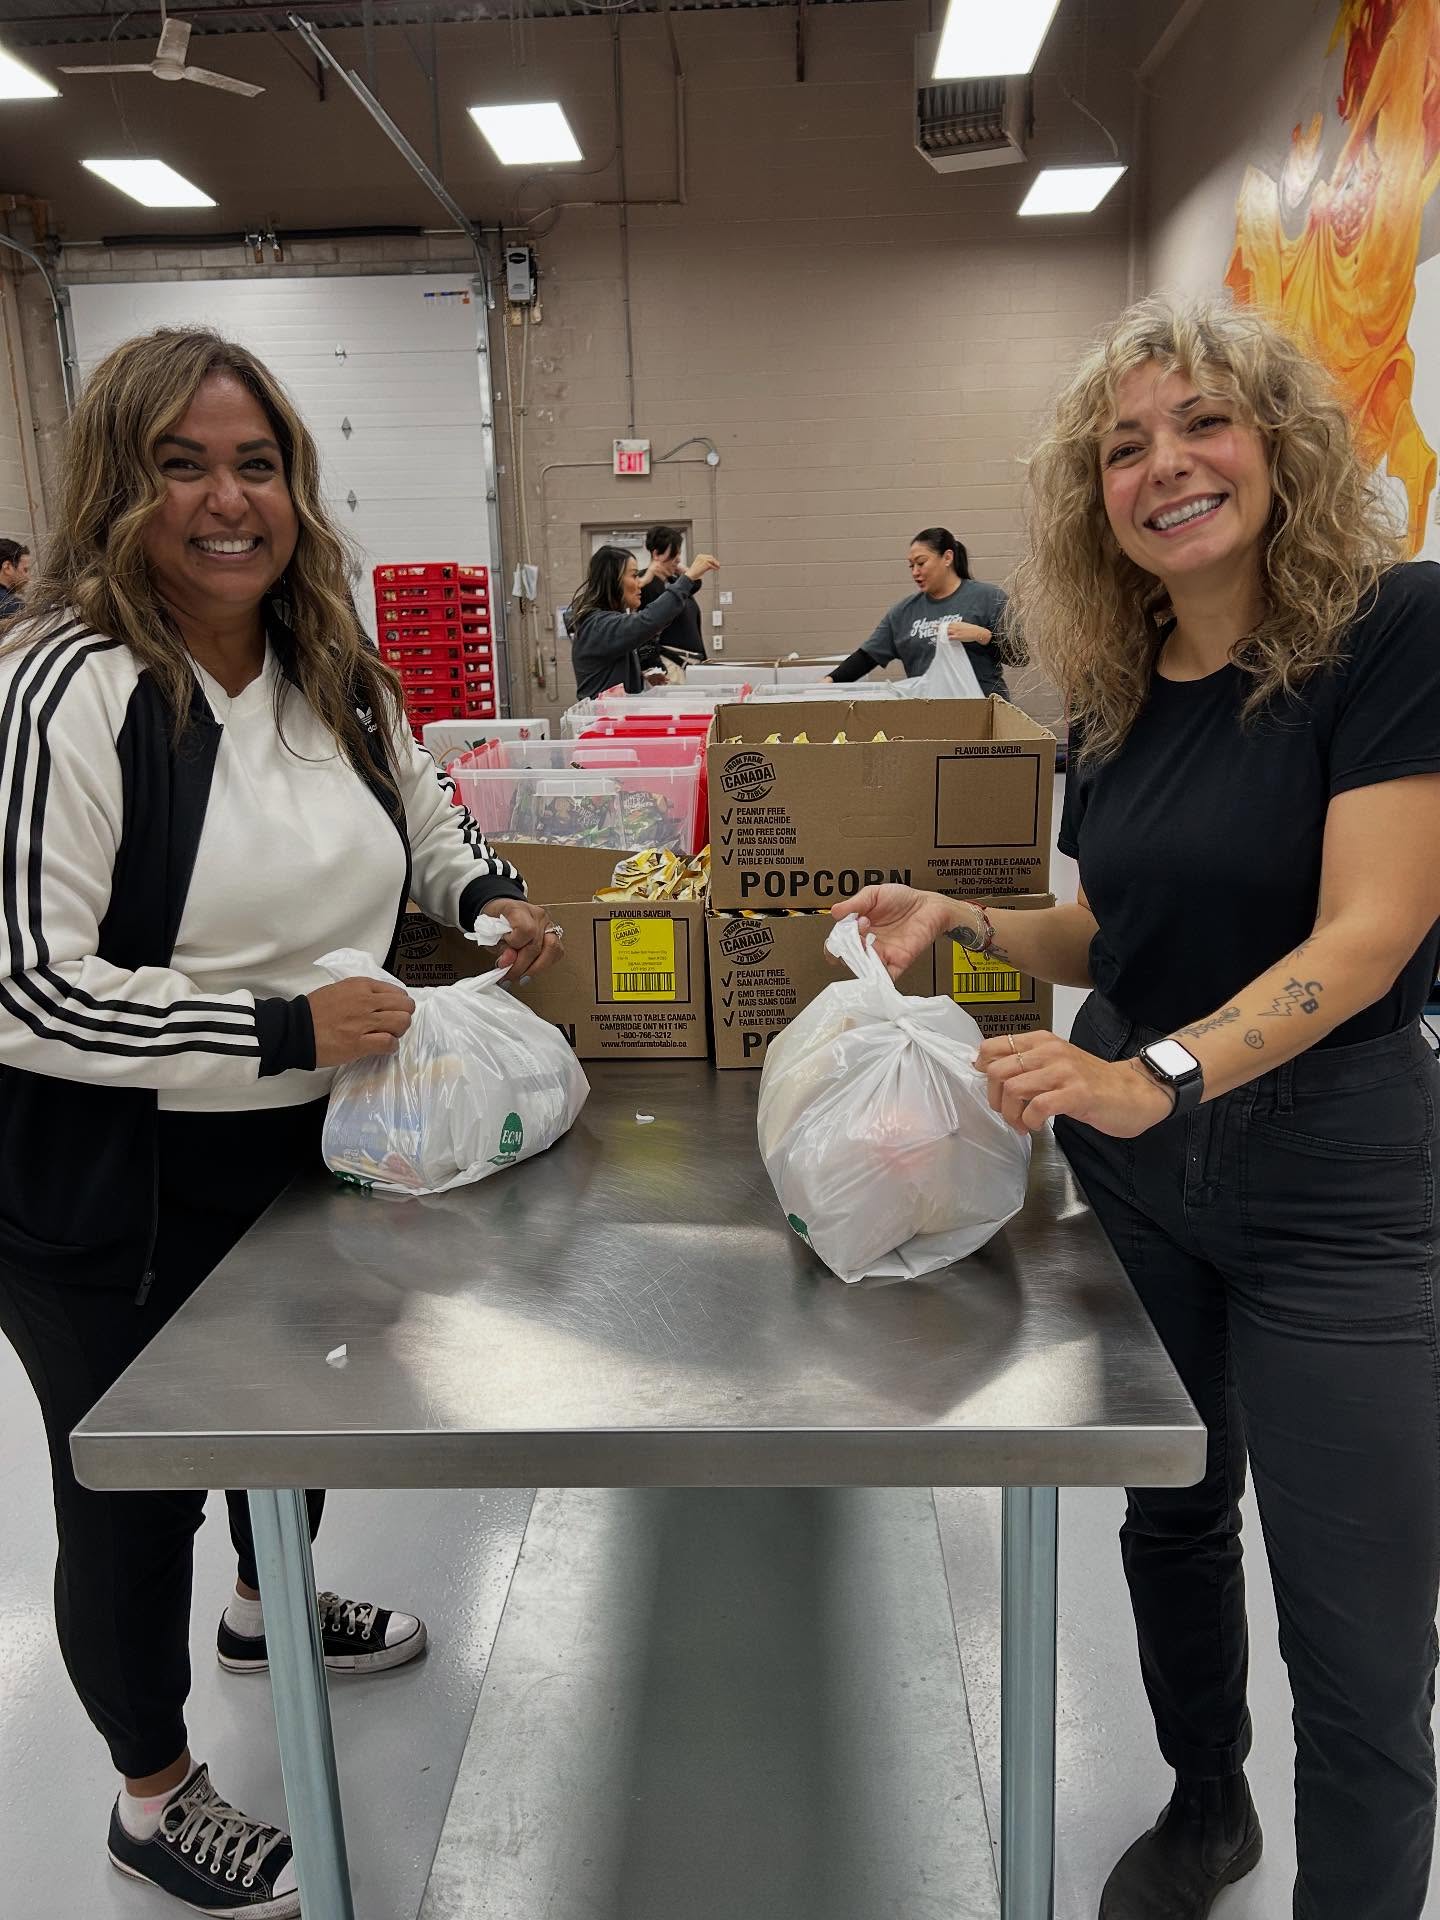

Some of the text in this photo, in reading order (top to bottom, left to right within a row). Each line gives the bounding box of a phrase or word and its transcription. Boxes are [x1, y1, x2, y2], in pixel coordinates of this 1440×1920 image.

[618, 452, 645, 472] EXIT
[955, 745, 1022, 755] FLAVOUR SAVEUR
[725, 755, 764, 774] FROM FARM
[724, 766, 772, 789] CANADA
[737, 785, 766, 800] TO TABLE
[767, 807, 786, 815] FREE
[737, 816, 791, 825] SAN ARACHIDE
[737, 827, 797, 836] GMO FREE CORN
[757, 837, 778, 845] SANS
[755, 848, 785, 856] SODIUM
[737, 858, 763, 866] FAIBLE
[776, 857, 805, 865] SODIUM
[928, 859, 949, 867] FROM
[950, 858, 973, 867] FARM
[985, 858, 1009, 866] TABLE
[1009, 857, 1042, 866] CANADA
[936, 868, 982, 876] CAMBRIDGE
[1016, 867, 1032, 875] 1N5
[740, 869, 912, 898] POPCORN
[954, 877, 1014, 885] 1-800-766-3212
[609, 910, 642, 918] FLAVOUR
[615, 927, 640, 940] CANADA
[724, 920, 761, 938] FROM FARM
[400, 924, 439, 945] ANADA
[723, 930, 770, 952] CANADA
[736, 949, 764, 963] TO TABLE
[405, 963, 453, 972] PEANUT FREE
[406, 972, 421, 980] SAN
[736, 969, 785, 978] PEANUT FREE
[737, 978, 790, 987] SAN ARACHIDE
[737, 988, 796, 998] GMO FREE CORN
[758, 998, 778, 1006] SANS
[738, 1009, 785, 1018] LOW SODIUM
[1009, 1013, 1040, 1021] CANADA
[739, 1018, 764, 1026] FAIBLE
[765, 1018, 775, 1026] EN
[502, 1130, 523, 1144] ECM
